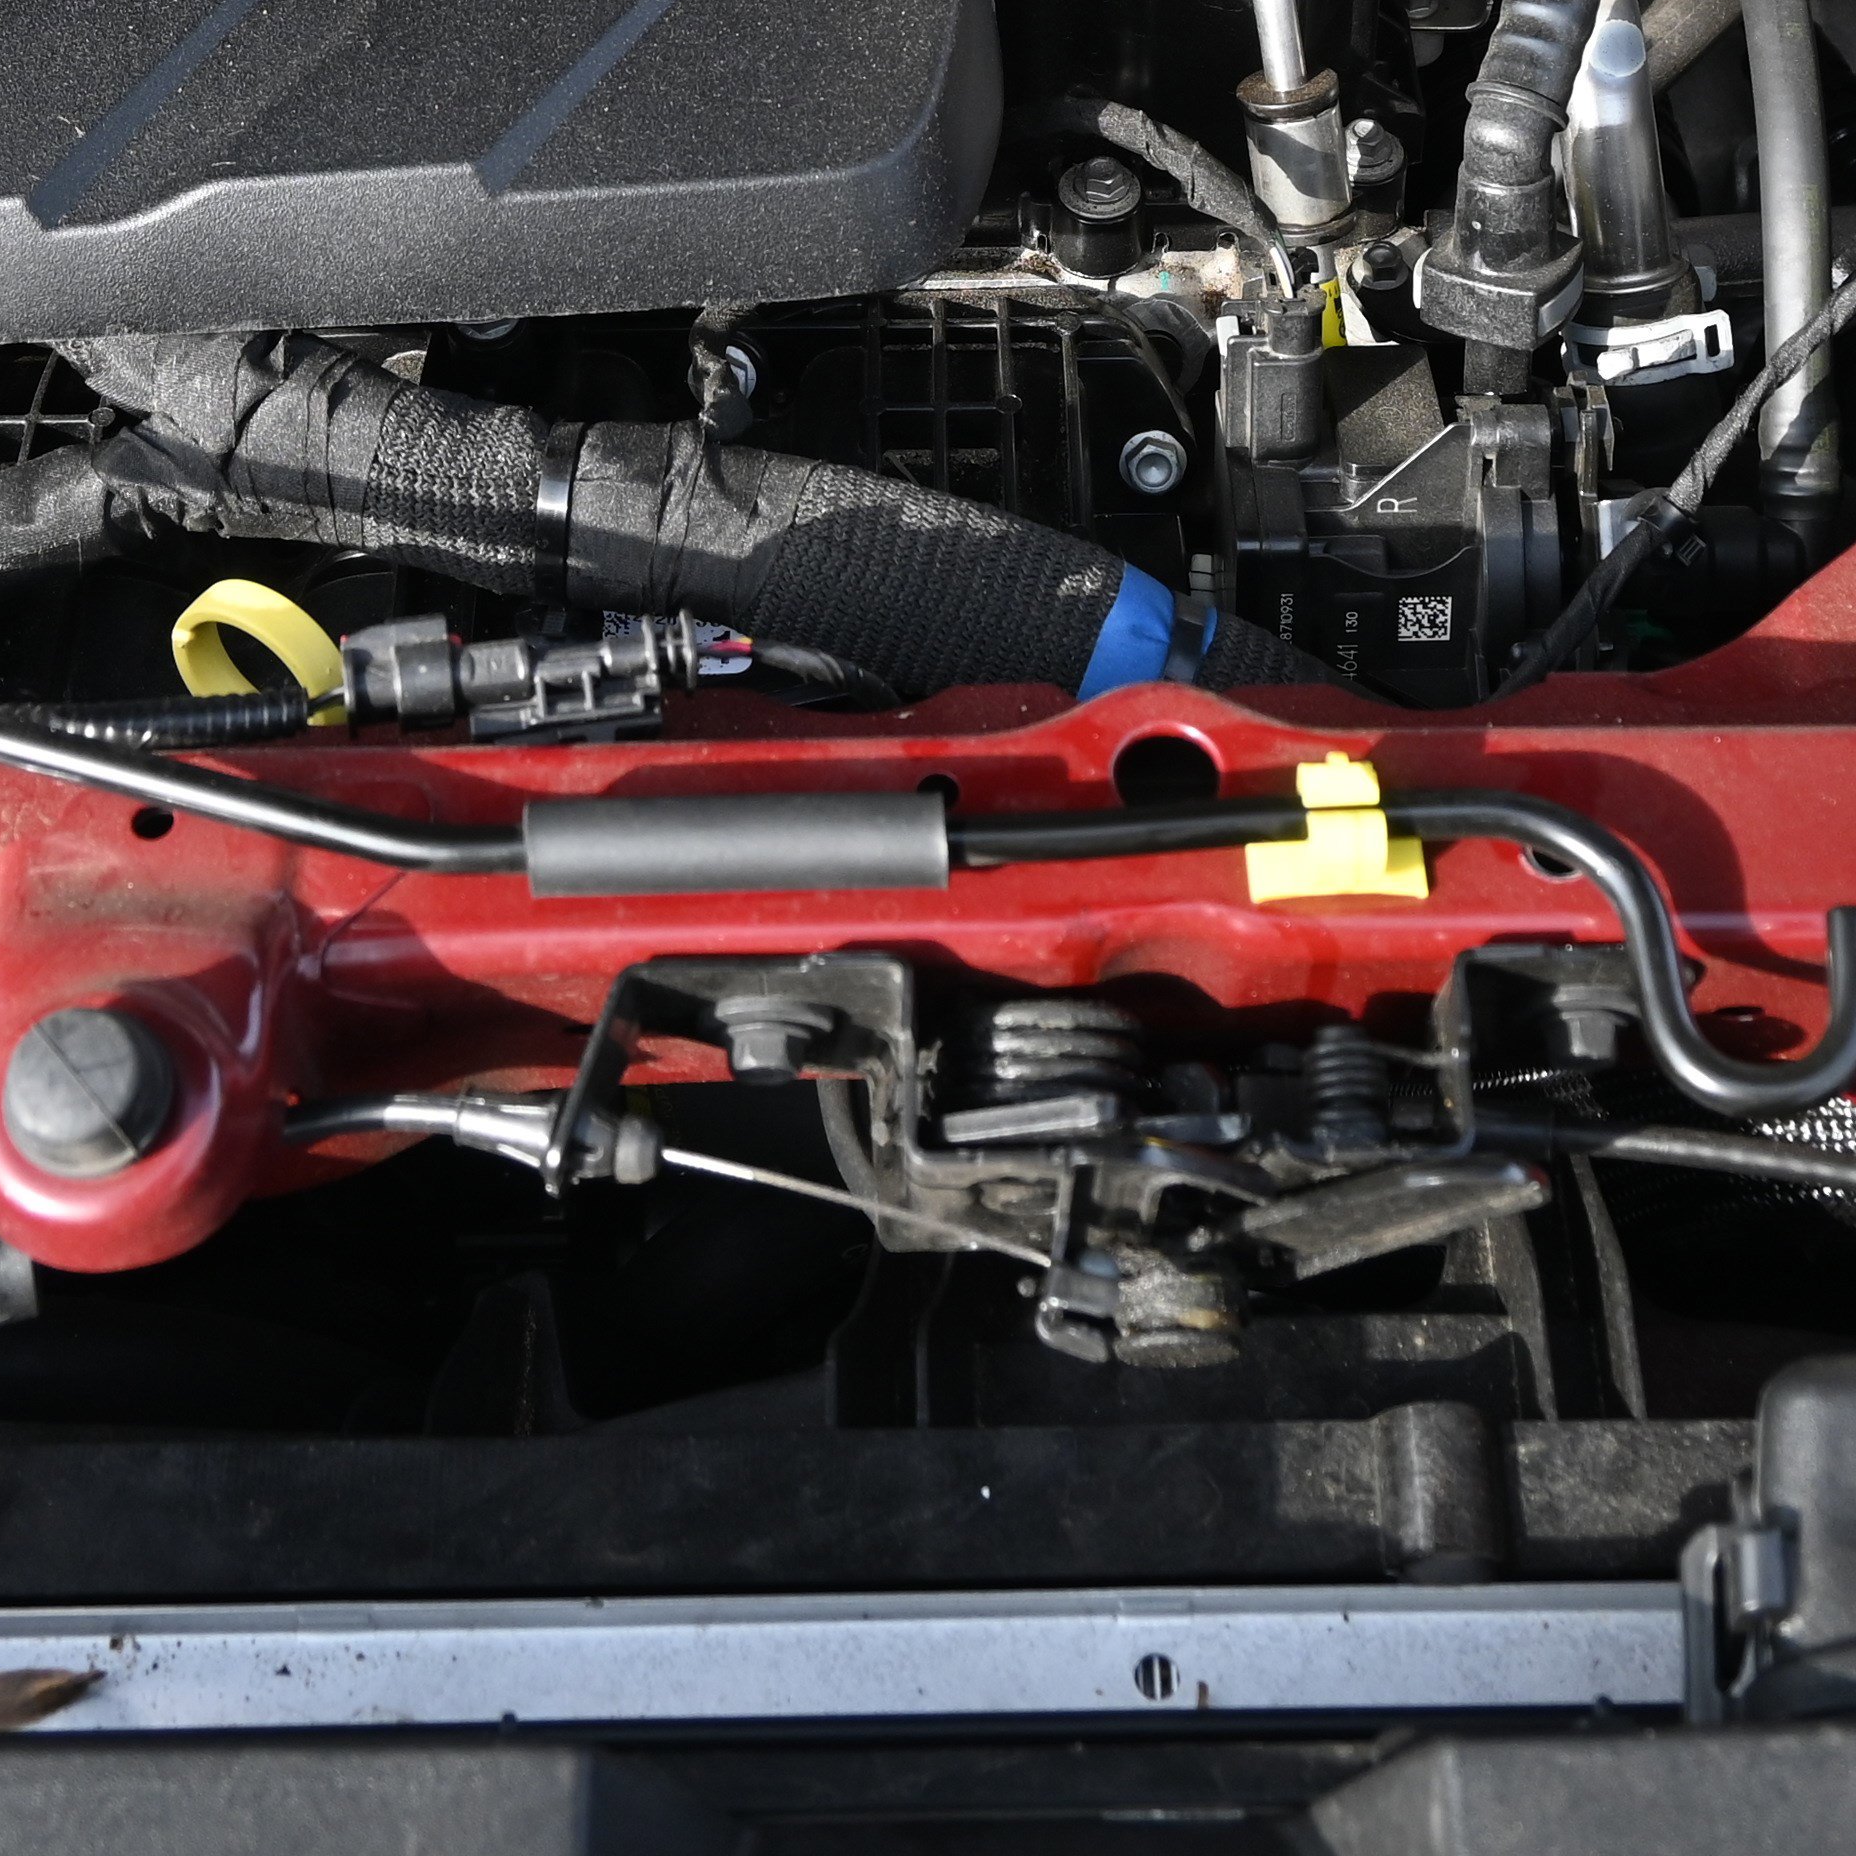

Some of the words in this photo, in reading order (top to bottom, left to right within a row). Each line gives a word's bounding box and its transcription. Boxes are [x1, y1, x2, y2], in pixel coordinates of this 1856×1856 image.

[1377, 497, 1417, 513] R
[1280, 594, 1294, 644] 8710931
[1345, 611, 1359, 633] 130
